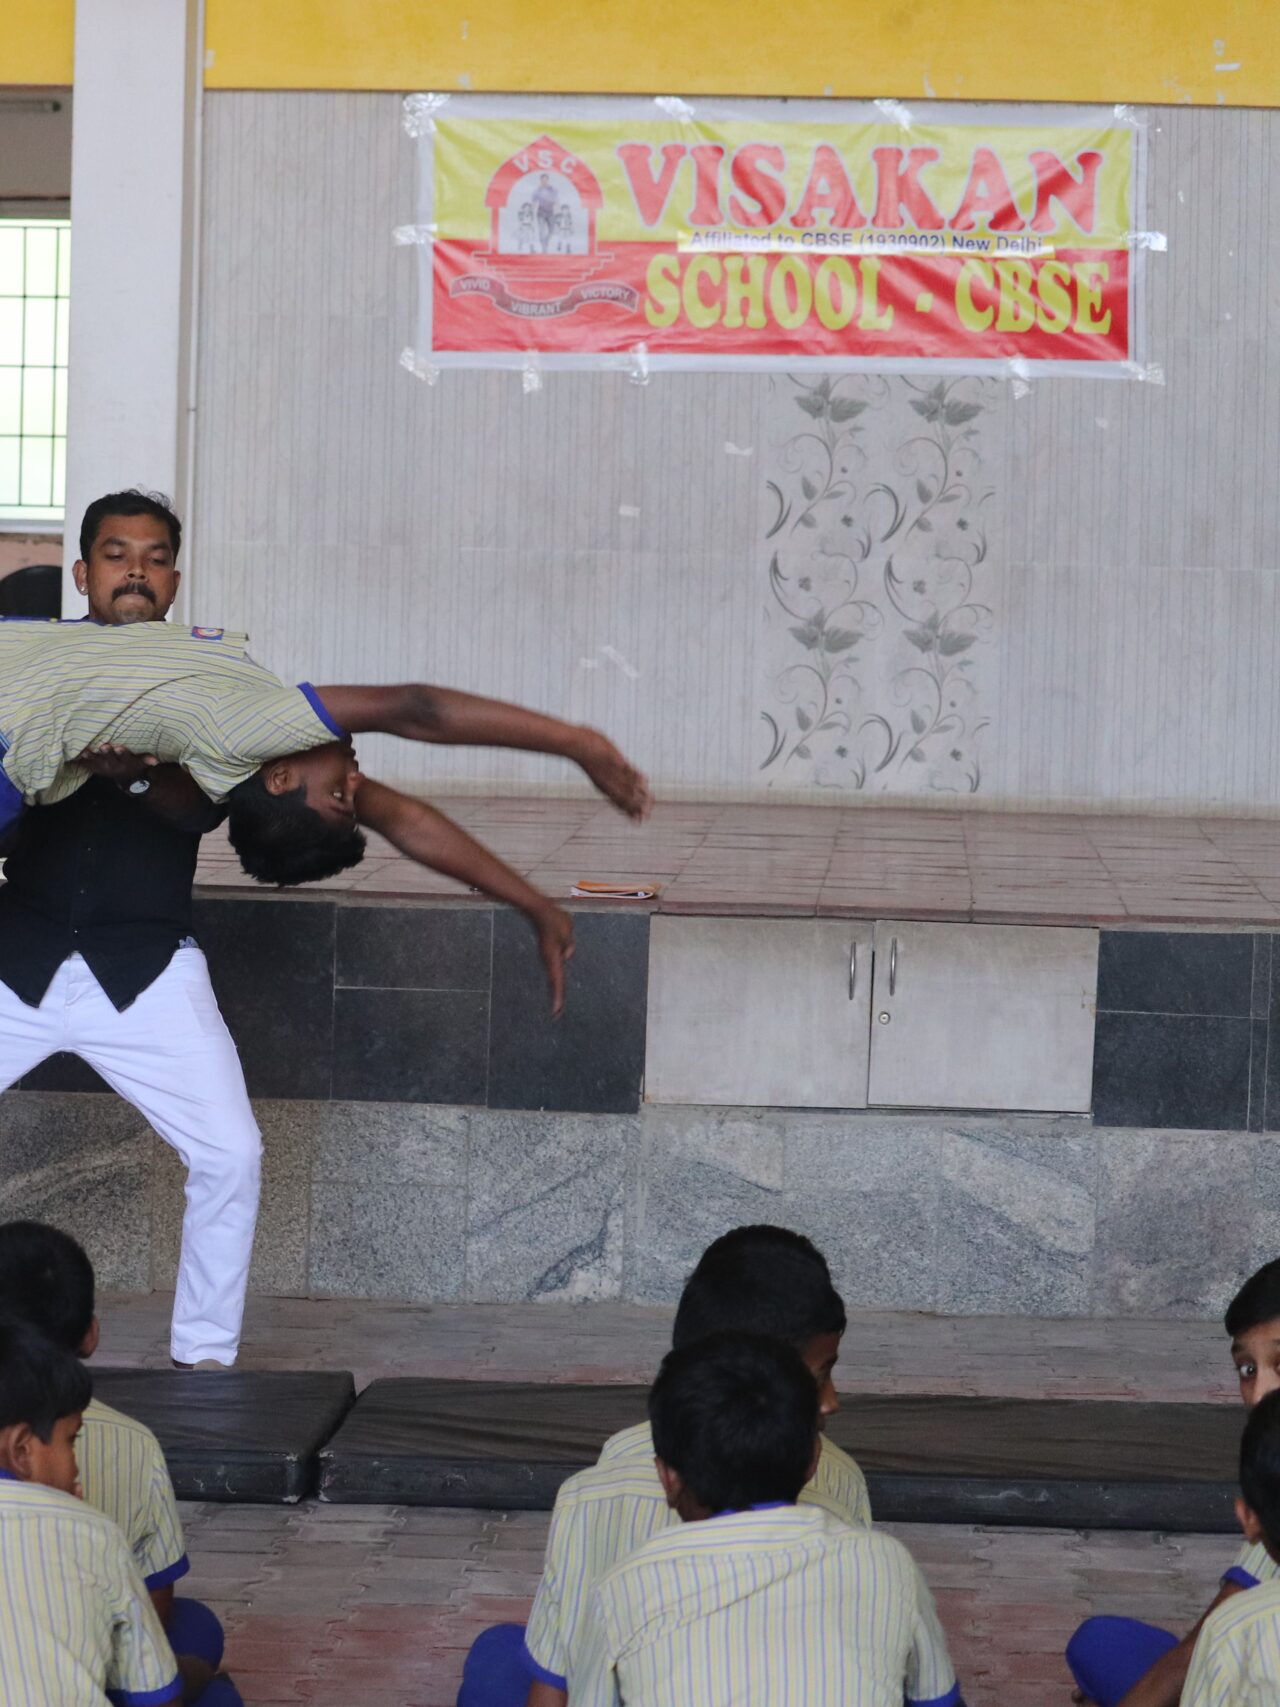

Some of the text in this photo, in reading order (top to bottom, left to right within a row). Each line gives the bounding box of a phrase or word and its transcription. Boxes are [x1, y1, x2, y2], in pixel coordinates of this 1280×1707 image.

[616, 142, 1104, 235] VISAKAN
[691, 232, 769, 248] Affiliated
[778, 233, 795, 247] to
[801, 232, 853, 247] CBSE
[952, 235, 990, 250] New
[996, 236, 1043, 252] Delhi
[460, 279, 631, 315] VIVID VIBRANT VICTORY
[644, 253, 893, 330] SCHOOL
[954, 258, 1113, 335] CBSE
